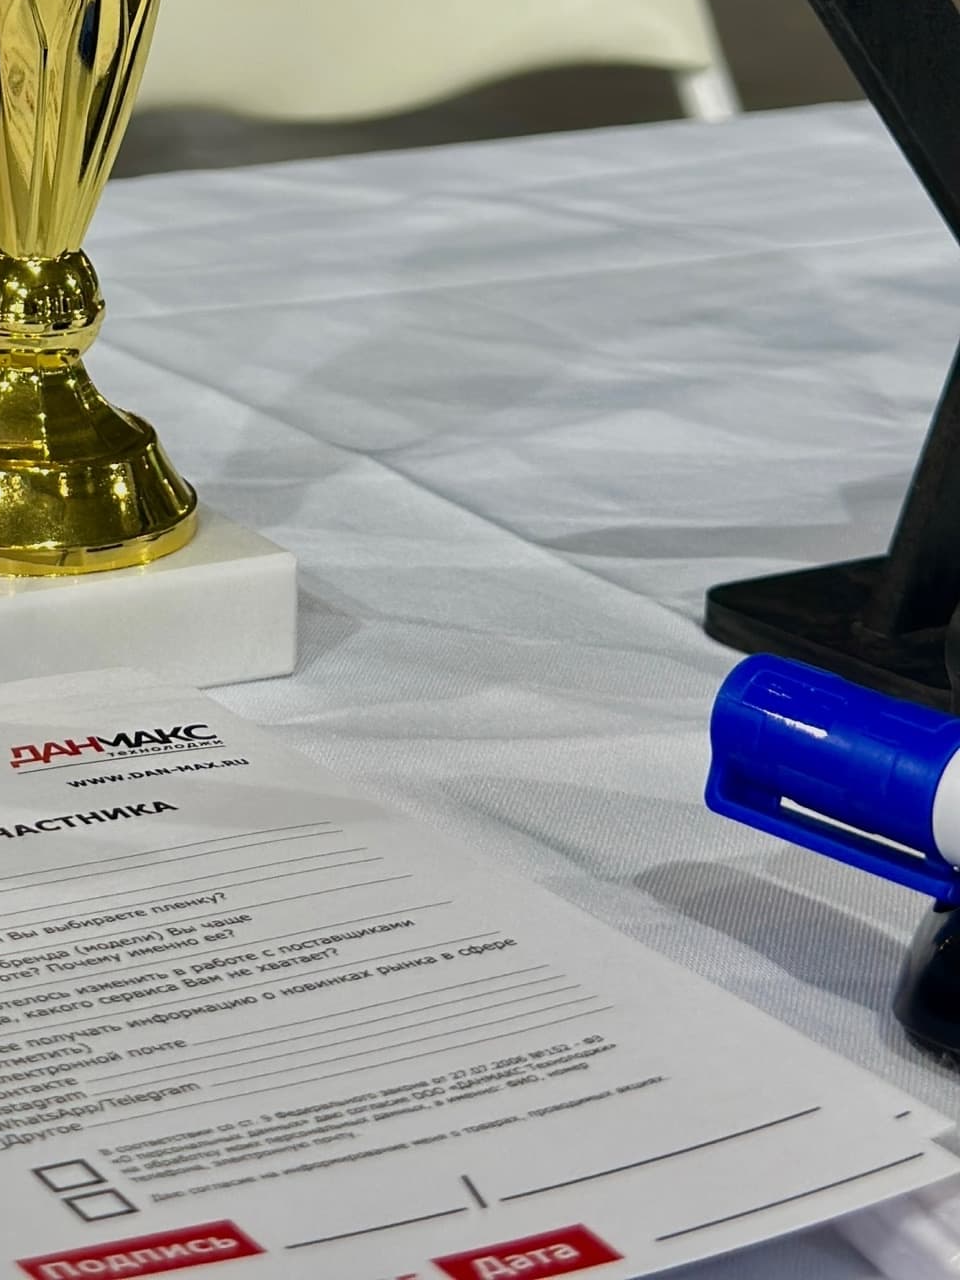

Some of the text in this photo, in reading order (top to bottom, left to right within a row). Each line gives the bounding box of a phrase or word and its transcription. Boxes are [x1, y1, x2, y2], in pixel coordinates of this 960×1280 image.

[9, 724, 217, 768] ДАНМАКС
[67, 759, 250, 788] WWW.DAN-MAX.RU
[6, 930, 39, 941] Вы
[42, 910, 148, 934] выбираете
[150, 892, 226, 914] пленку?
[74, 931, 164, 956] (модели)
[165, 925, 197, 936] Вы
[200, 914, 253, 928] чаще
[45, 953, 121, 973] Почему
[126, 938, 200, 958] именно
[203, 929, 235, 942] ее?
[75, 973, 169, 995] изменить
[172, 968, 187, 976] в
[189, 953, 259, 974] работе
[261, 949, 276, 957] с
[277, 920, 415, 954] поставщиками
[23, 1000, 94, 1019] какого
[98, 984, 180, 1005] сервиса
[180, 975, 223, 988] Вам
[226, 968, 254, 979] не
[255, 947, 338, 973] хватает?
[25, 1025, 123, 1048] получать
[126, 996, 258, 1028] информацию
[261, 992, 276, 1000] о
[279, 970, 374, 996] новинках
[376, 956, 438, 976] рынка
[458, 939, 518, 956] сфере
[126, 1040, 188, 1057] почте
[1, 1123, 84, 1148] Другое
[40, 1237, 238, 1279] Подпись
[471, 1243, 581, 1280] Дата
